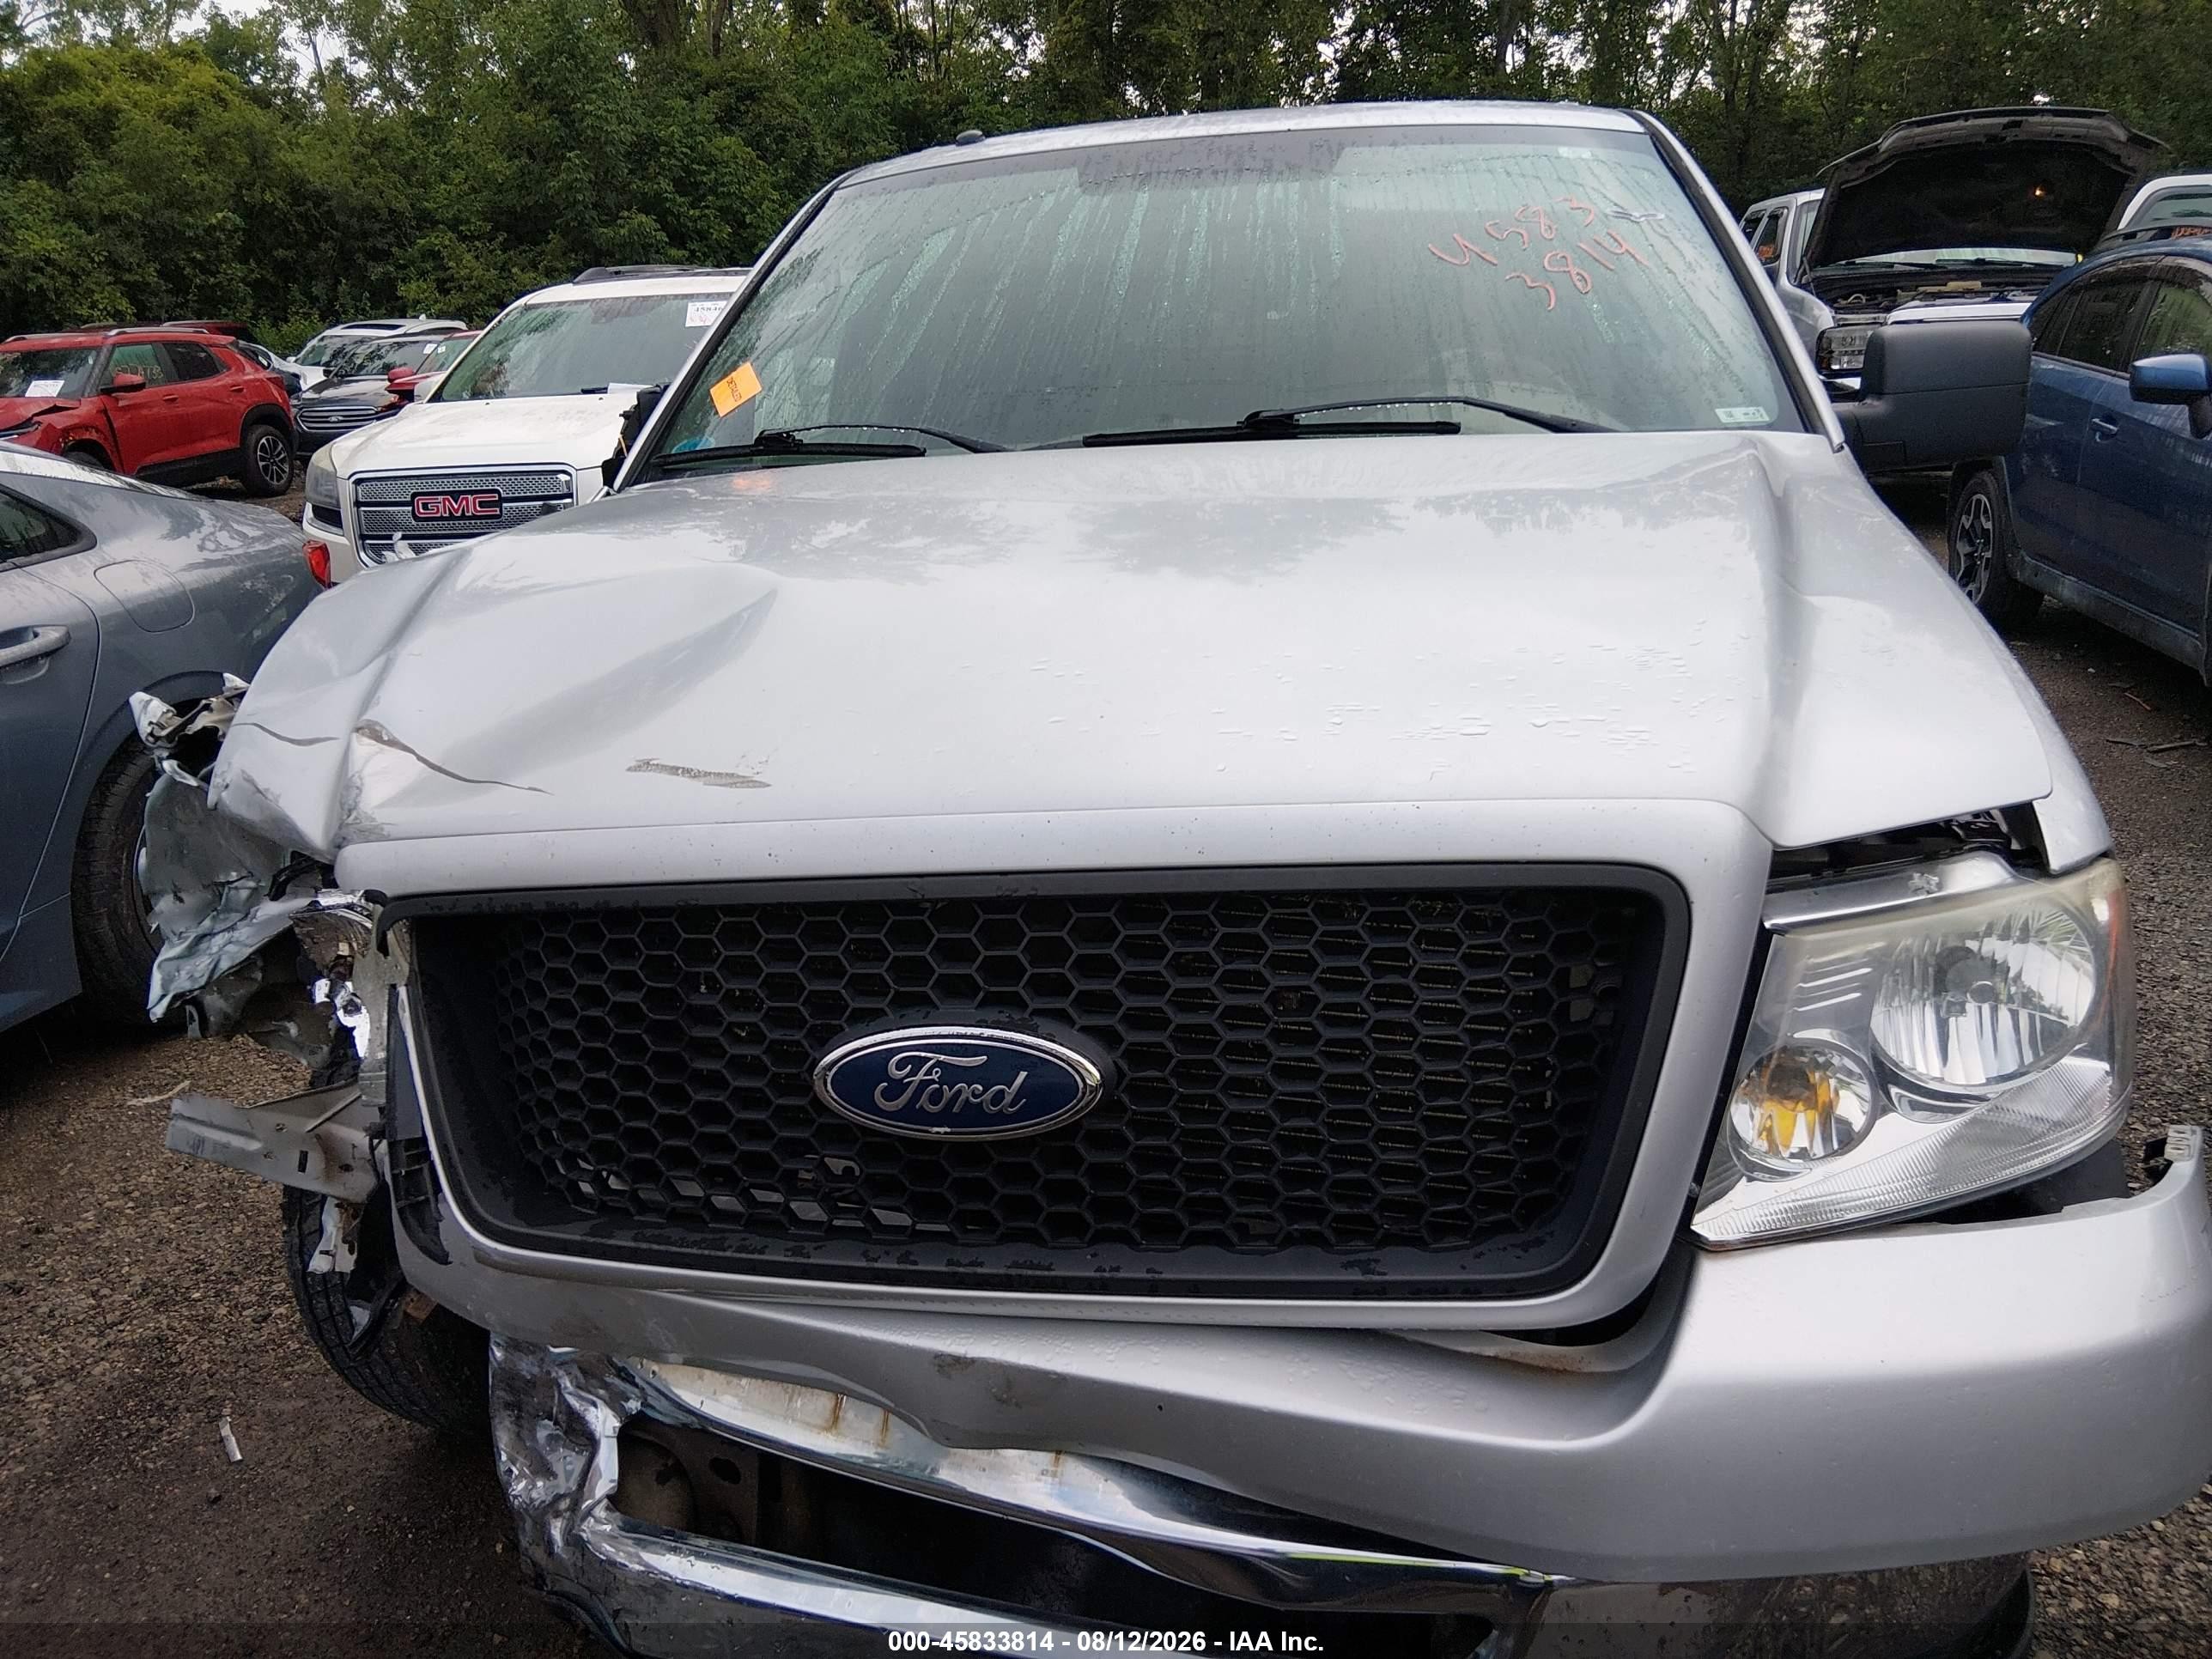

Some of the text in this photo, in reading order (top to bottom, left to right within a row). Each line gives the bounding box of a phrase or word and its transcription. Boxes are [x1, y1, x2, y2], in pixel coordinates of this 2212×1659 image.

[1427, 195, 1596, 267] 4583
[1504, 228, 1650, 312] 3814
[414, 494, 501, 517] GMC
[873, 1051, 1030, 1115] Ford
